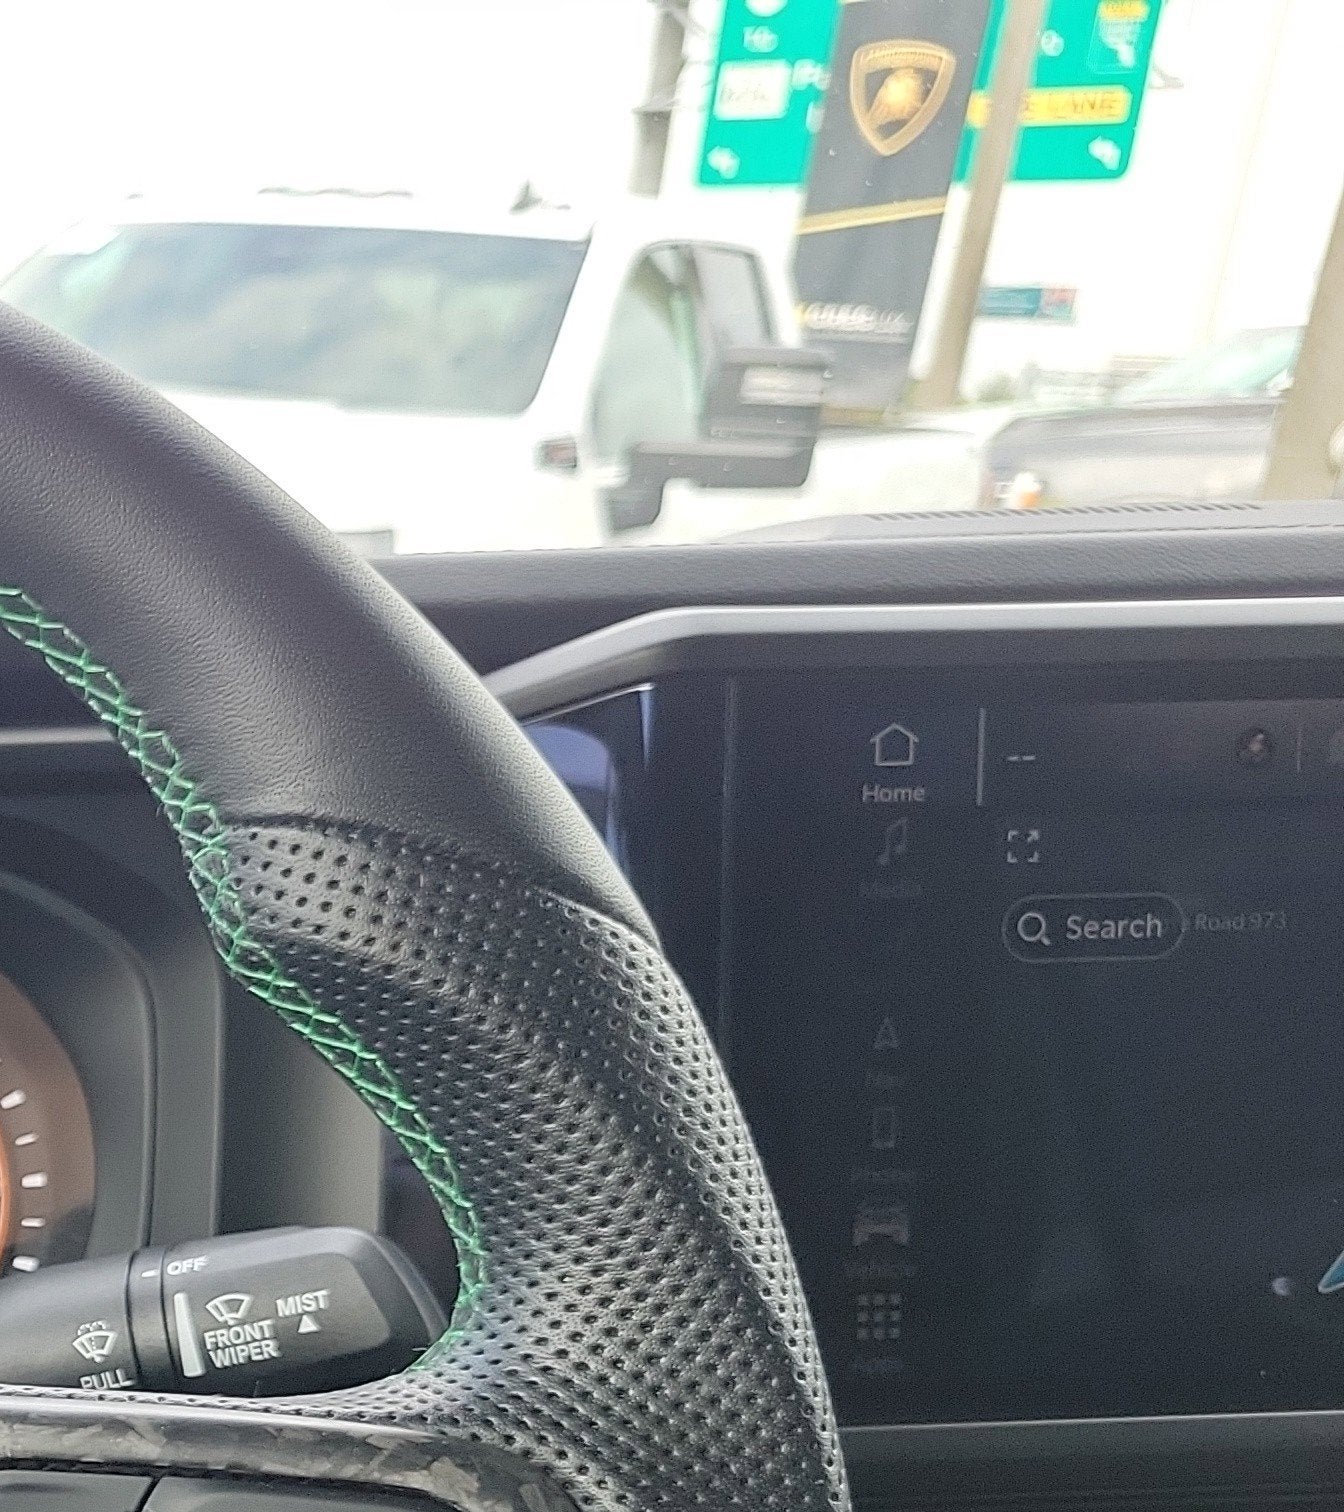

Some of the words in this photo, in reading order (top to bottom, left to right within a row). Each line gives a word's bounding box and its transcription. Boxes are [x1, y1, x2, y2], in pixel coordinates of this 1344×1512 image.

[862, 784, 925, 802] Home
[1066, 913, 1163, 940] Search
[166, 1255, 210, 1276] OFF
[275, 1288, 331, 1318] MIST
[203, 1318, 275, 1351] FRONT
[208, 1338, 282, 1369] WIPER
[79, 1368, 136, 1391] PULL
